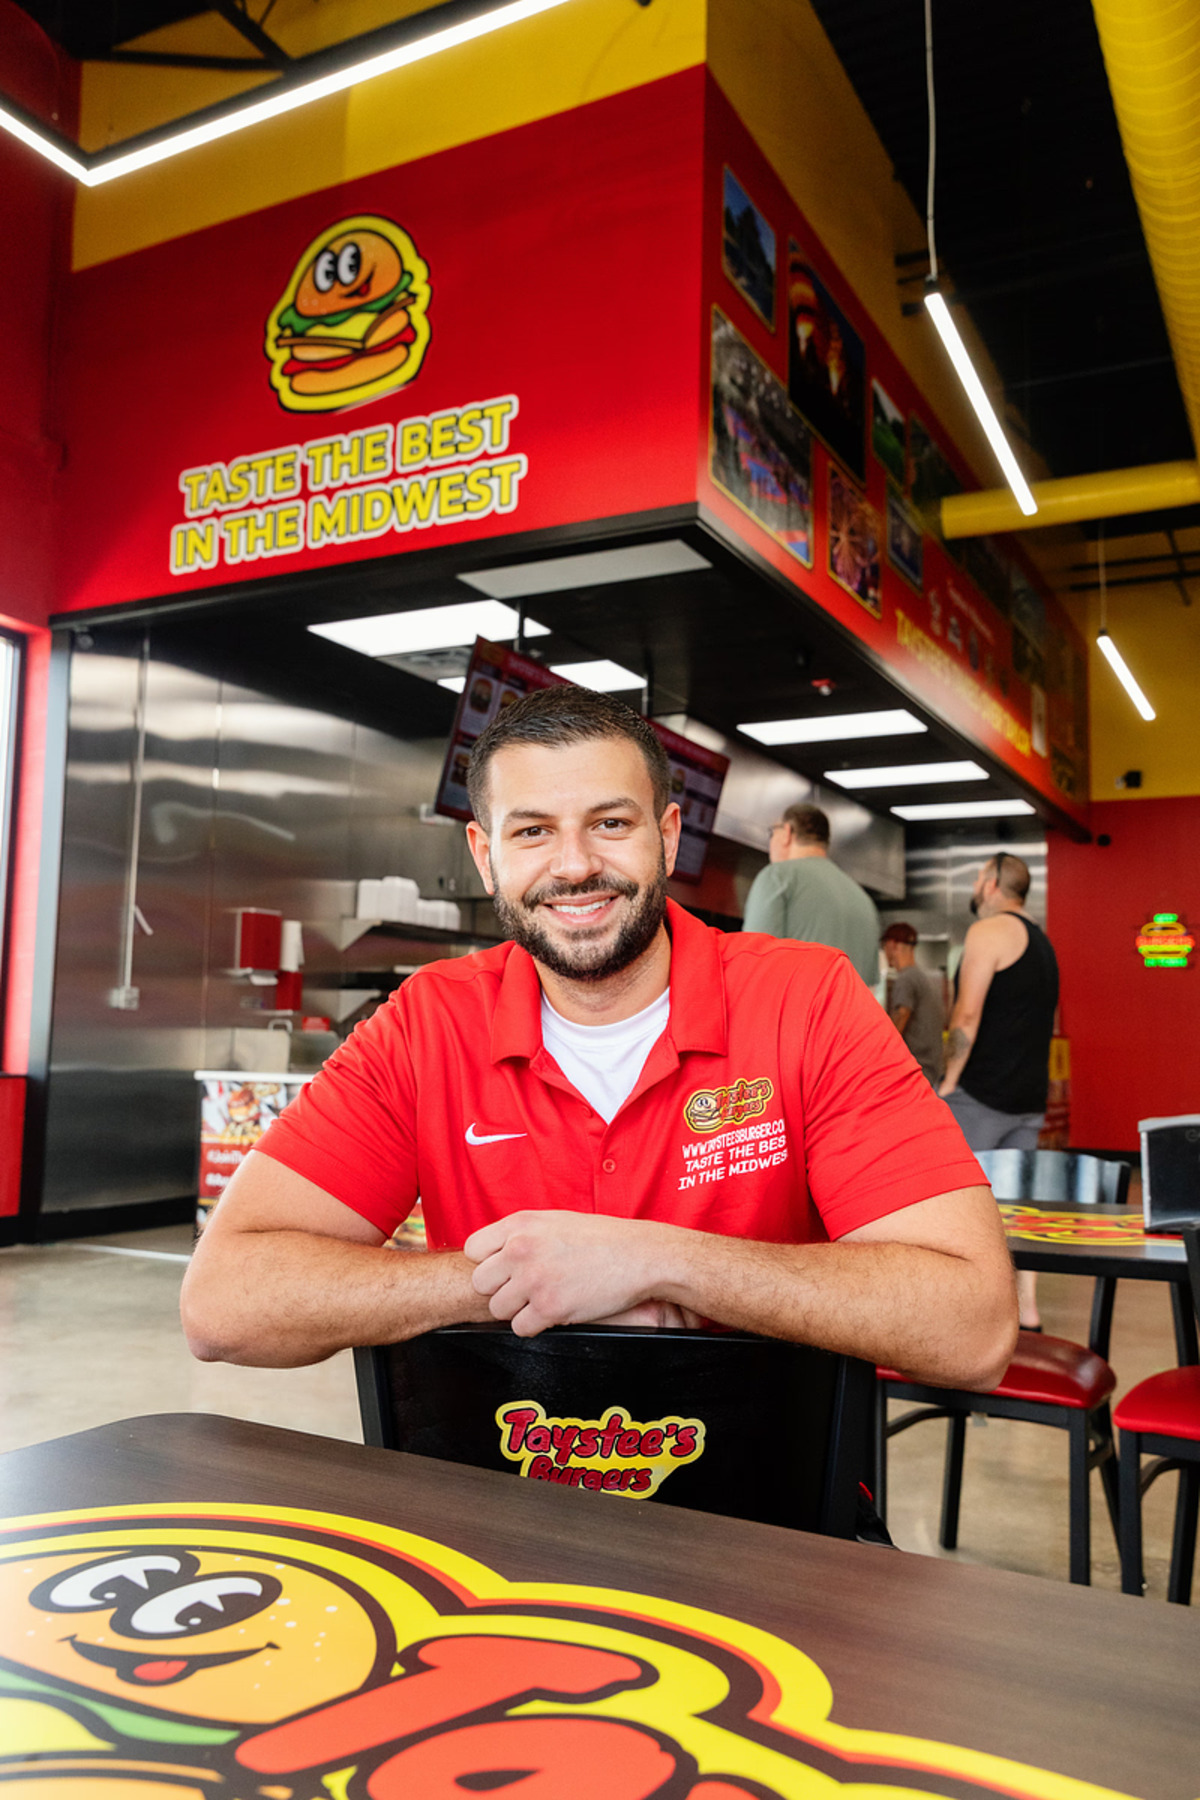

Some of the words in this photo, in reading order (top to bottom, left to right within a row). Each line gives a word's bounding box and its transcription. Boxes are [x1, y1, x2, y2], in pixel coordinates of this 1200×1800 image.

[182, 448, 299, 514] TASTE
[305, 427, 391, 488] THE
[398, 398, 515, 470] BEST
[172, 521, 216, 571] IN
[221, 503, 302, 560] THE
[309, 457, 524, 546] MIDWEST
[678, 1175, 696, 1190] IN
[699, 1167, 726, 1184] THE
[729, 1148, 788, 1176] MIDWES
[685, 1151, 724, 1172] TASTE
[729, 1143, 755, 1161] THE
[758, 1135, 786, 1153] BES
[503, 1408, 697, 1465] Taystee's
